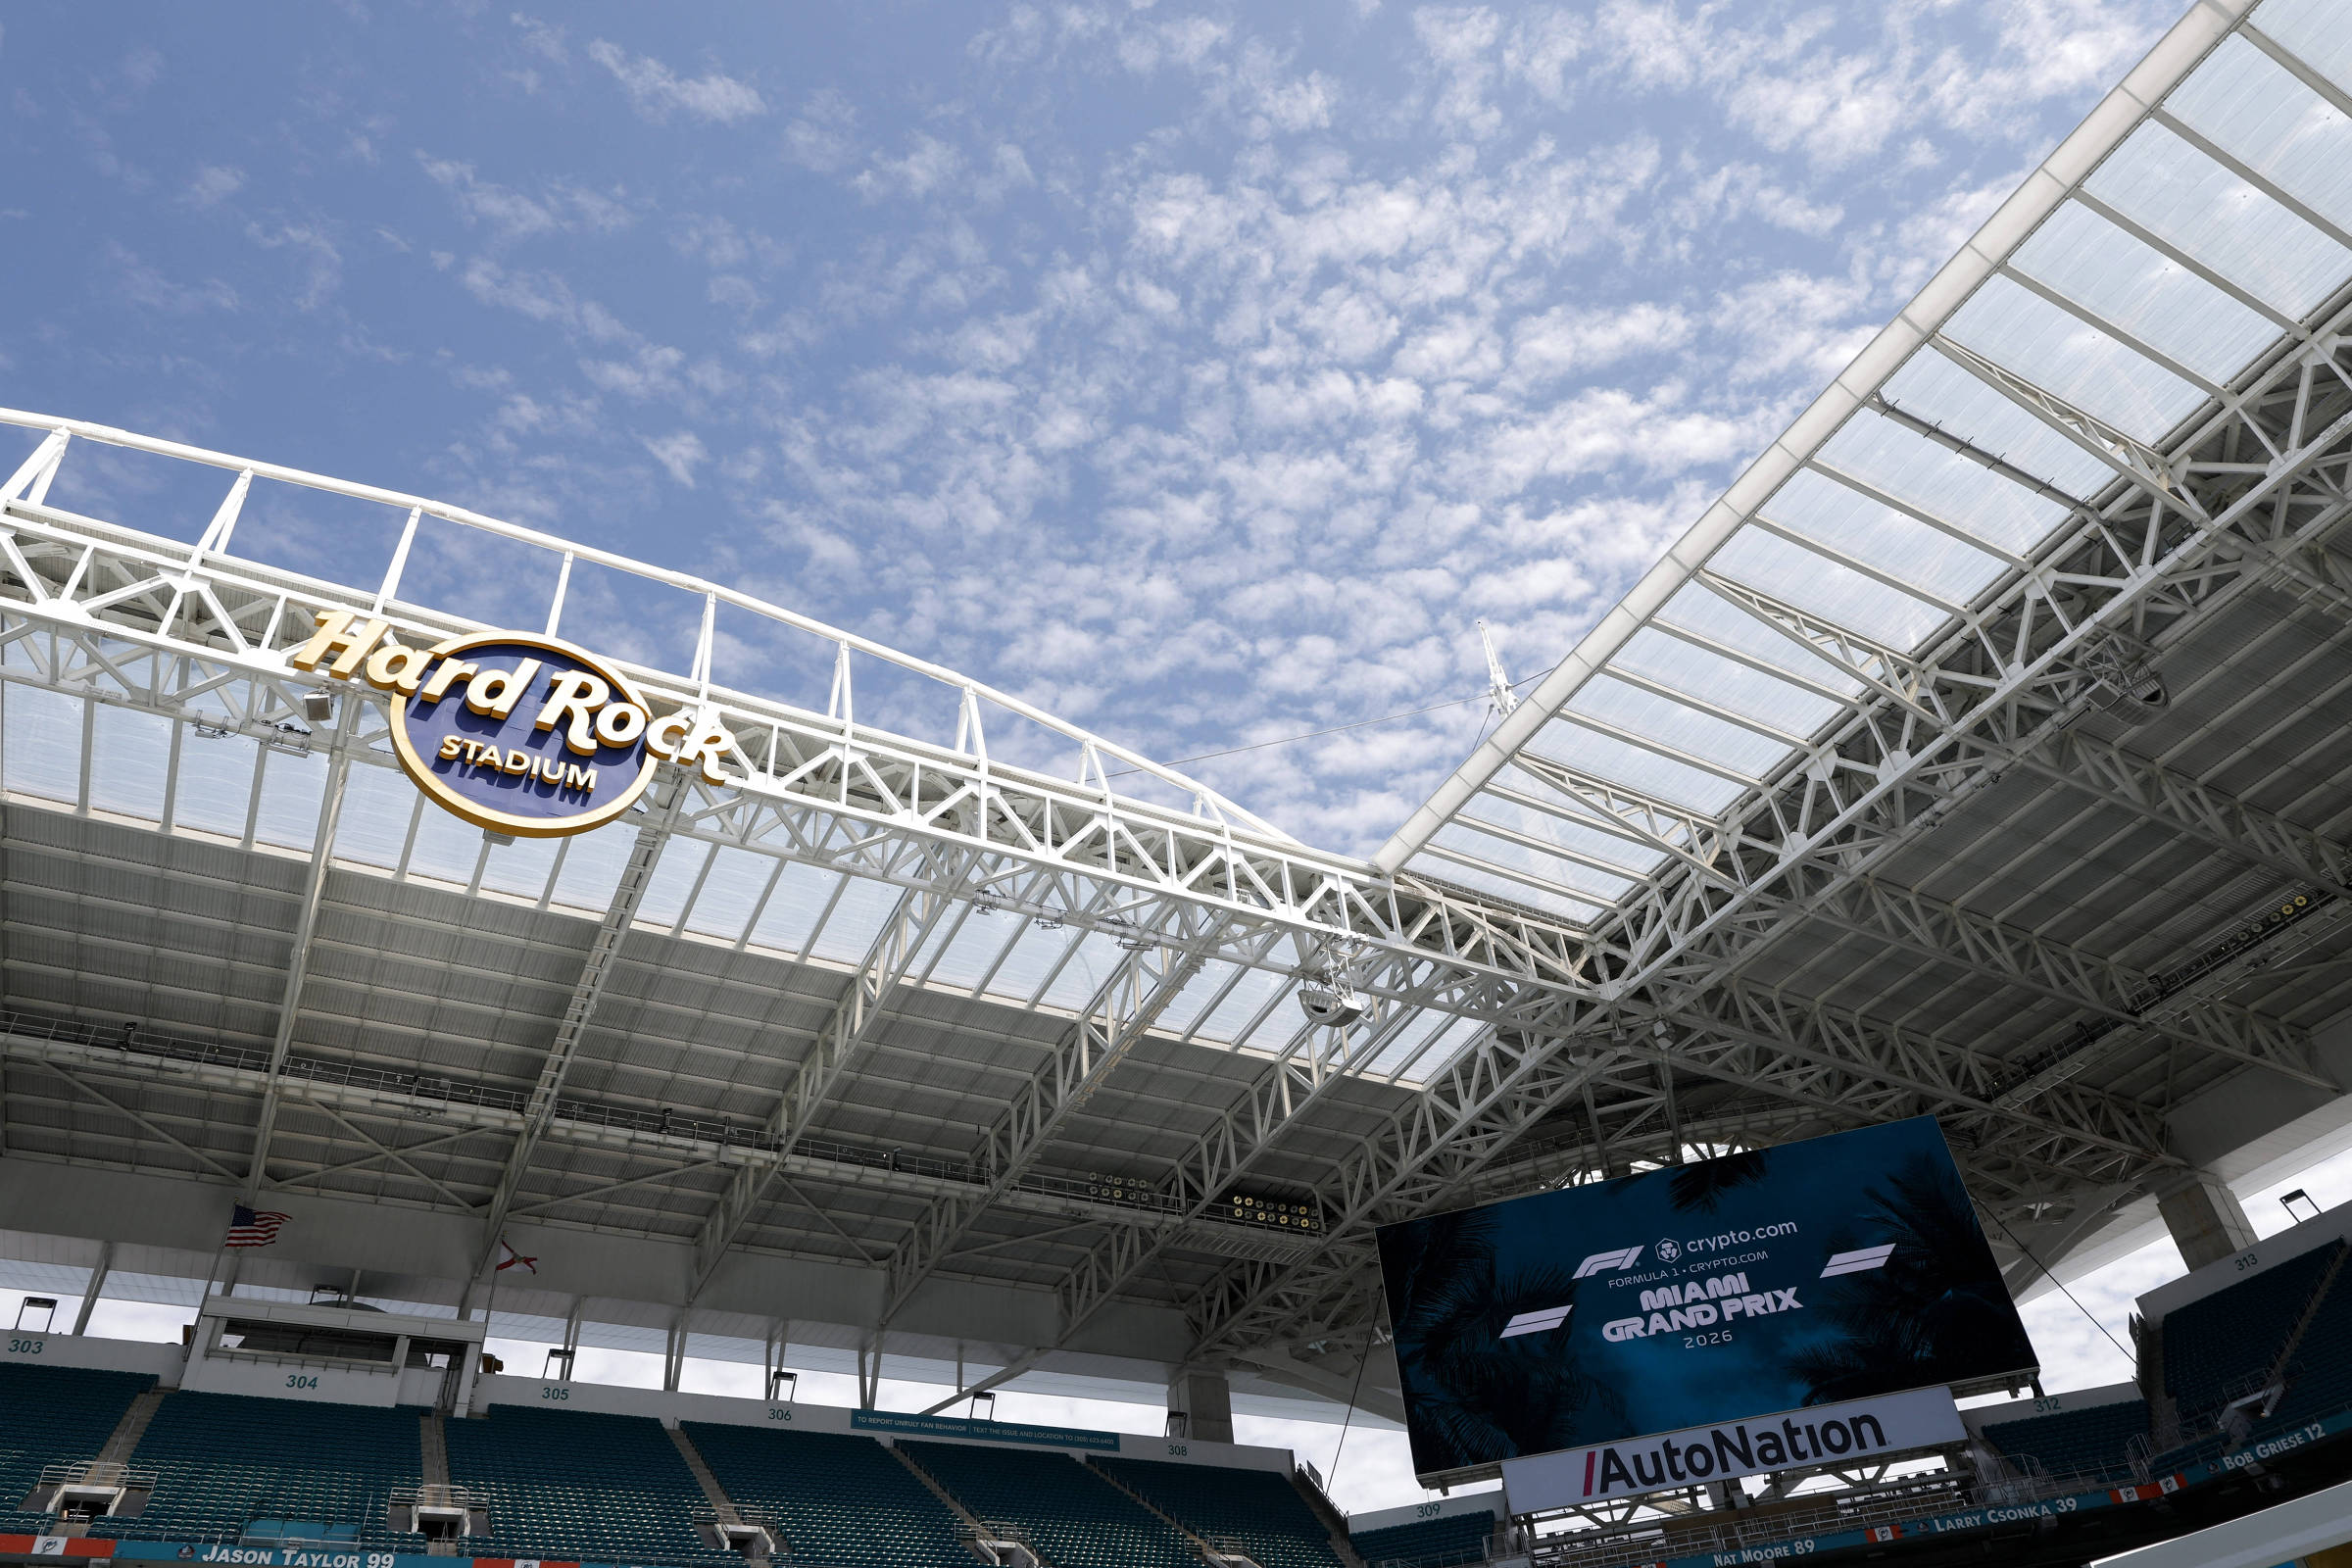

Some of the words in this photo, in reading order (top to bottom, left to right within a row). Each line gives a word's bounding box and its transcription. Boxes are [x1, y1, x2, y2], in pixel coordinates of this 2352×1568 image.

[294, 611, 542, 720] Hard
[536, 668, 737, 786] Rock
[438, 735, 598, 794] STADIUM
[1687, 1221, 1798, 1253] crypto.com
[1608, 1269, 1669, 1289] FORMULA
[1672, 1267, 1680, 1277] 1
[1689, 1250, 1769, 1273] CRYPTO.COM
[2235, 1253, 2258, 1272] 313
[1640, 1272, 1750, 1311] MIAMI
[1602, 1303, 1718, 1343] GRAND
[1720, 1287, 1804, 1322] PRIX
[8, 1339, 43, 1354] 303
[1683, 1330, 1734, 1349] 2026
[286, 1374, 318, 1390] 304
[542, 1387, 569, 1401] 305
[768, 1408, 792, 1422] 306
[2034, 1396, 2062, 1413] 312
[895, 1419, 919, 1428] UNRULY
[935, 1423, 967, 1432] BEHAVIOR
[1168, 1444, 1188, 1457] 308
[1599, 1413, 1886, 1494] AutoNation
[2222, 1451, 2255, 1471] BOB
[2256, 1433, 2305, 1458] GRIESE
[2304, 1423, 2327, 1441] 12
[1416, 1503, 1441, 1519] 309
[1934, 1515, 1982, 1532] LARRY
[1986, 1504, 2053, 1524] CSONKA
[2056, 1497, 2078, 1513] 39
[202, 1544, 273, 1565] JASON
[280, 1549, 361, 1568] TAYLOR
[367, 1553, 395, 1568] 99
[1713, 1553, 1737, 1567] NAT
[1741, 1545, 1791, 1563] MOORE
[1793, 1539, 1816, 1554] 89
